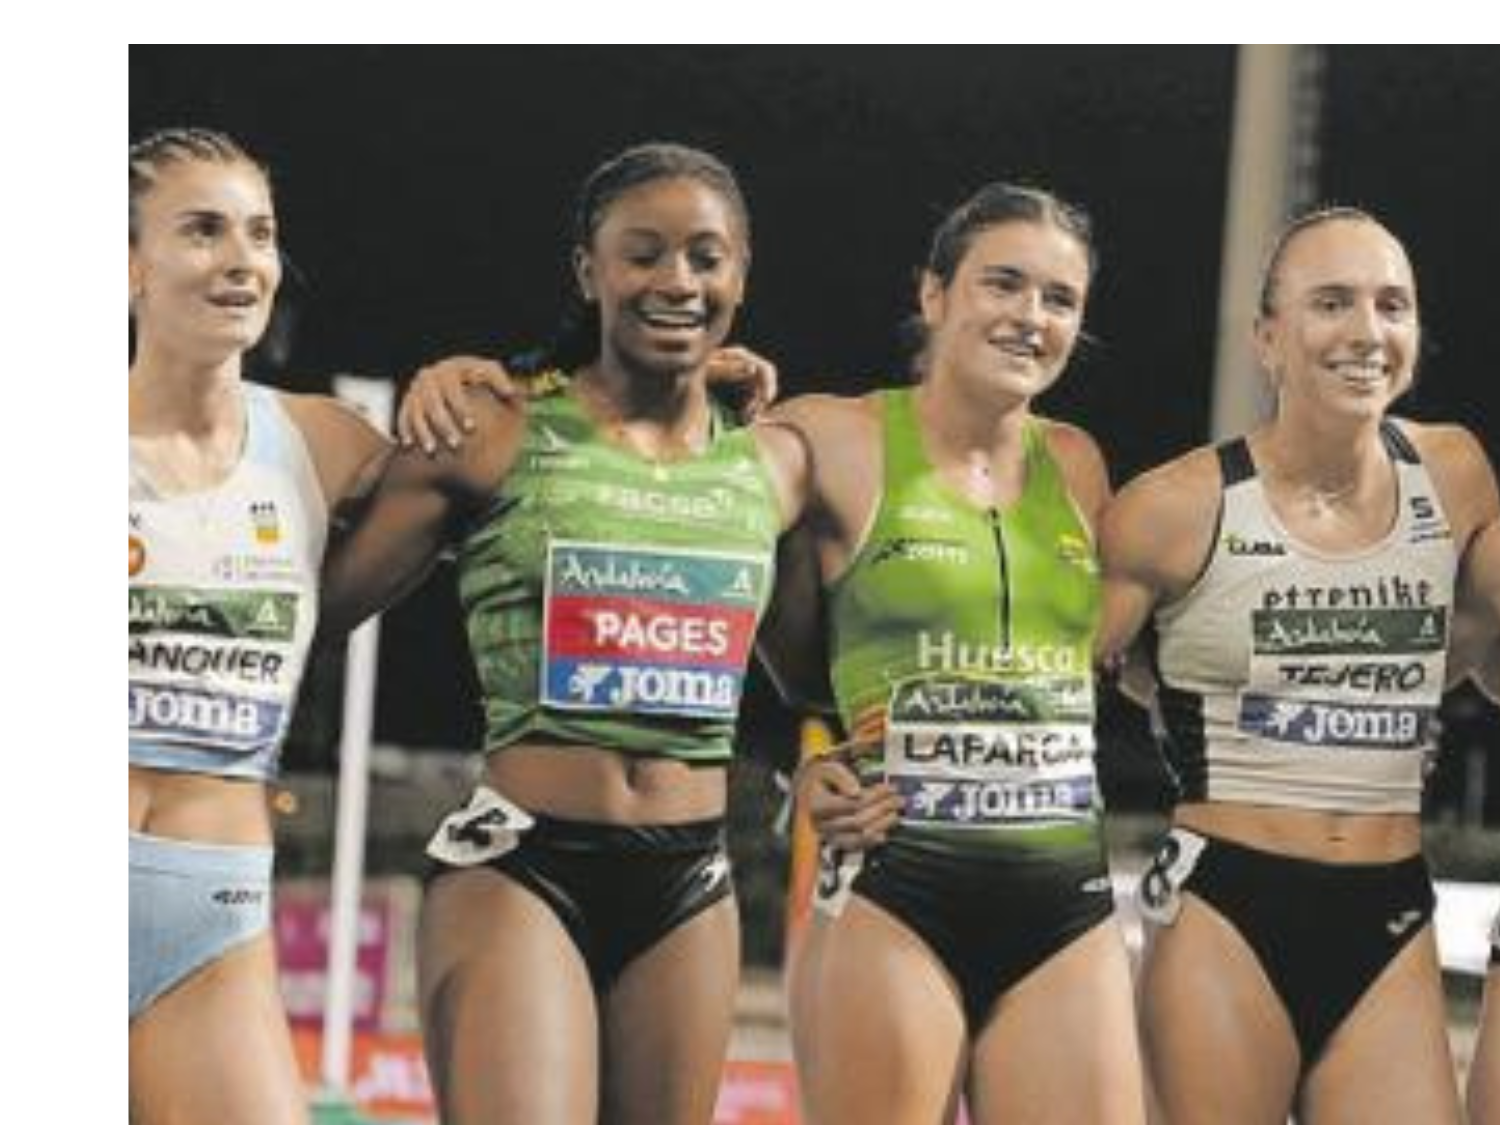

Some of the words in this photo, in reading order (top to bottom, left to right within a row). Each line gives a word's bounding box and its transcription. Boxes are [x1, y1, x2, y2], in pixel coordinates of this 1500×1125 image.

[592, 610, 730, 655] PAGES
[917, 631, 1076, 674] Huesca
[1279, 662, 1425, 692] TEJERO
[1142, 835, 1180, 908] 8
